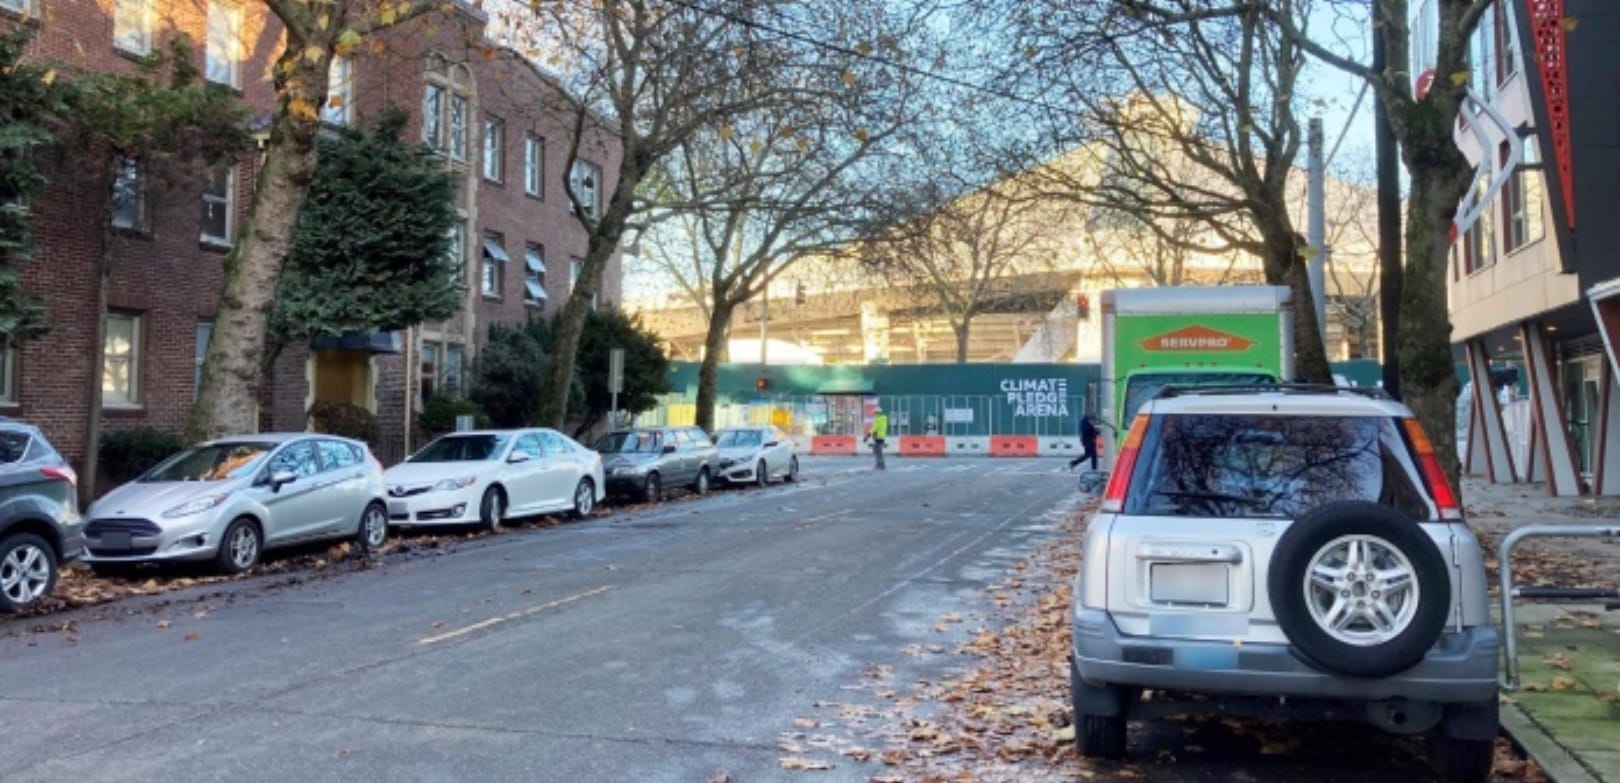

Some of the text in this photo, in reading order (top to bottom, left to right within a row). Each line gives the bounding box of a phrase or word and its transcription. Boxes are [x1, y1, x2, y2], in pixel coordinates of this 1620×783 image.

[1000, 378, 1067, 391] CLIMATE
[1007, 391, 1067, 404] PLEDGE
[1014, 403, 1069, 416] ARENA
